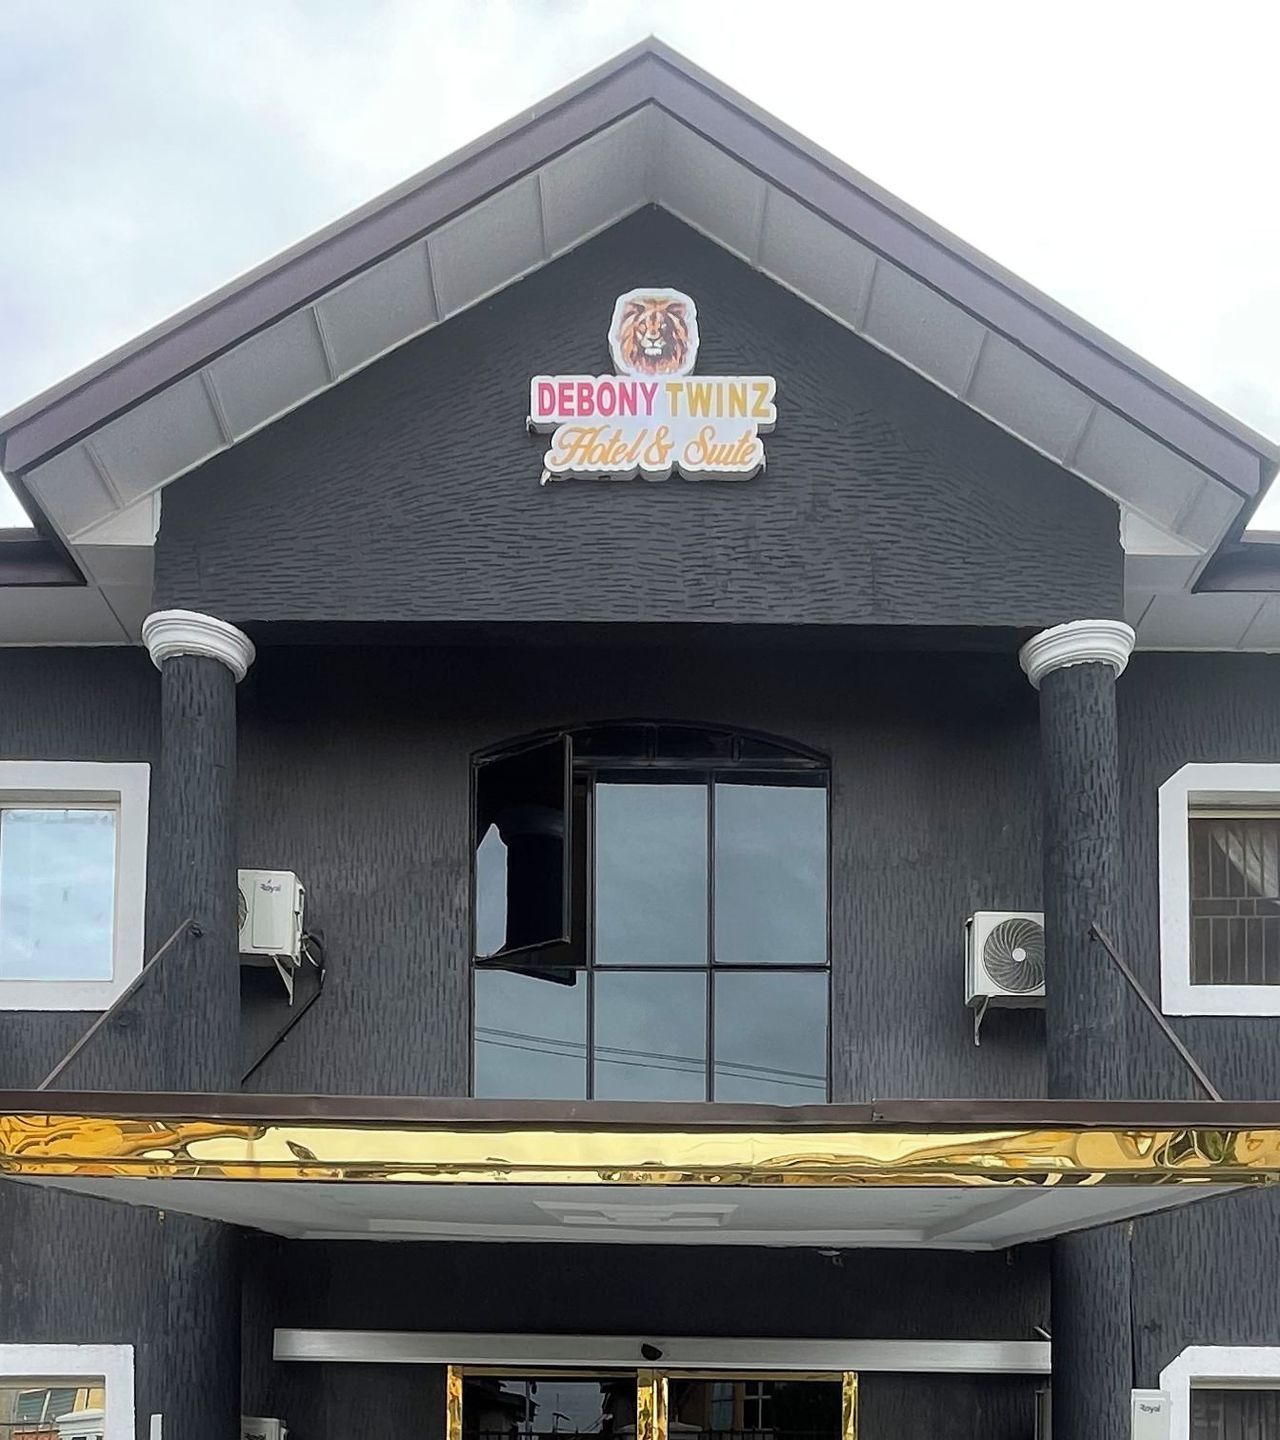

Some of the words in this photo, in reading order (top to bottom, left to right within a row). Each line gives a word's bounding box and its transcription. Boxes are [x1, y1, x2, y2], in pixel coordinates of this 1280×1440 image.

[538, 382, 658, 417] DEBONY
[665, 383, 770, 417] TWINZ
[551, 425, 648, 466] Hotel
[644, 425, 674, 465] &
[1140, 1403, 1161, 1414] Royal
